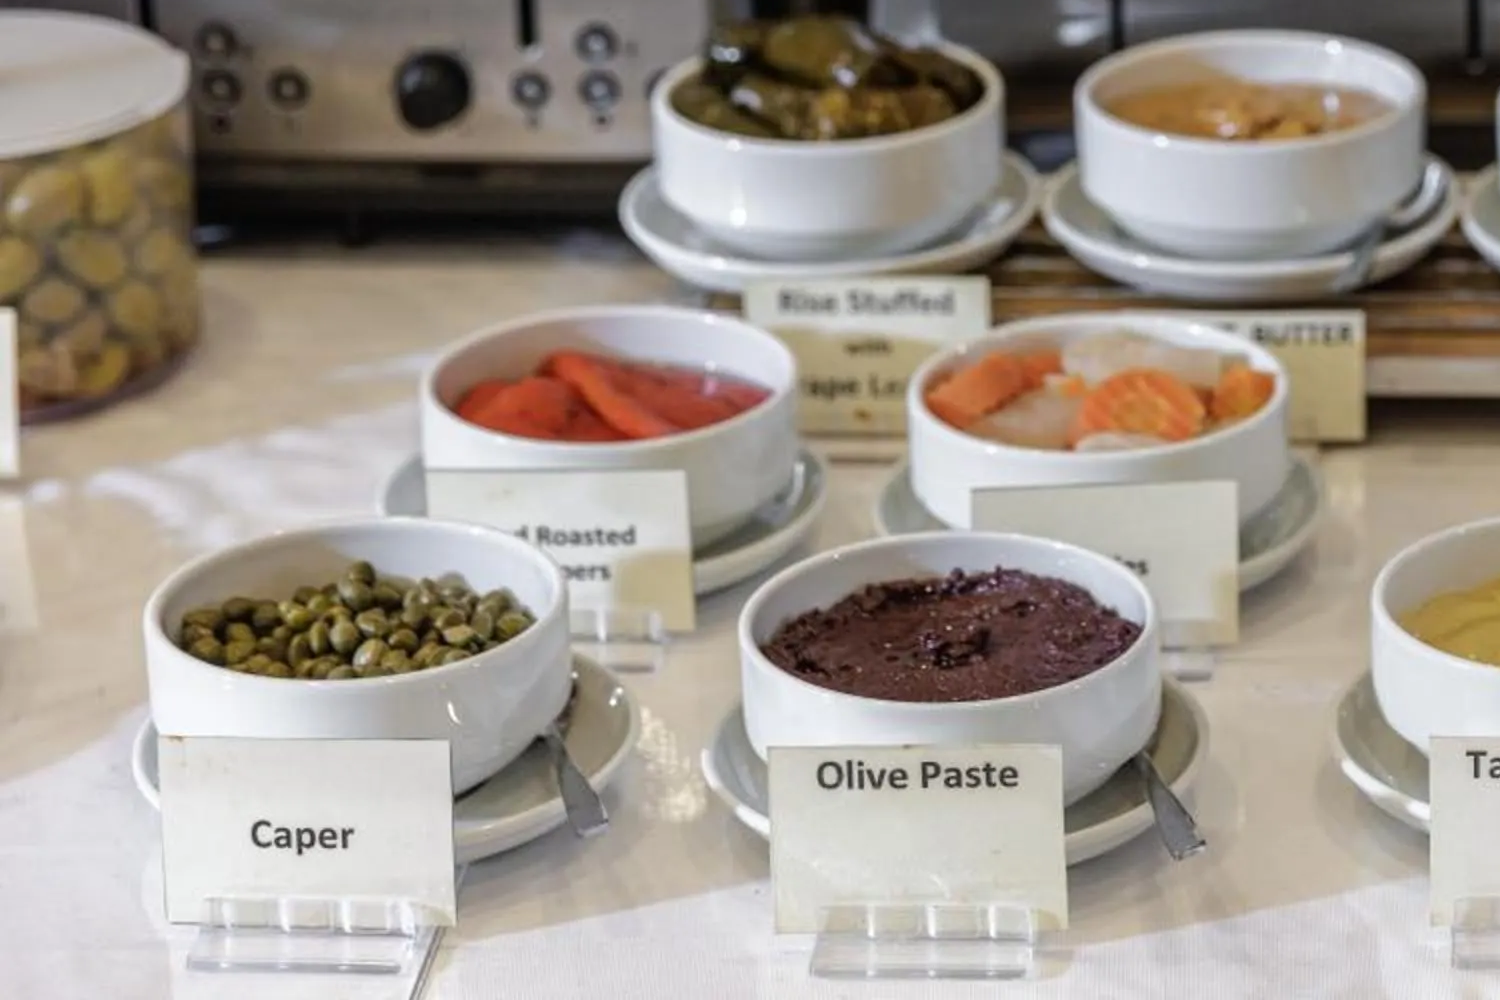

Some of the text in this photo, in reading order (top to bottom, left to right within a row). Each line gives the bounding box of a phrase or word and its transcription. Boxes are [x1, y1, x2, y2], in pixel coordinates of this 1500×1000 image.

[847, 288, 955, 315] Stuffed
[1255, 322, 1354, 345] BUTTER
[845, 338, 892, 354] with
[799, 376, 860, 399] rape
[536, 525, 637, 546] Roasted
[816, 760, 1019, 790] Olive Paste
[250, 820, 355, 856] Caper
